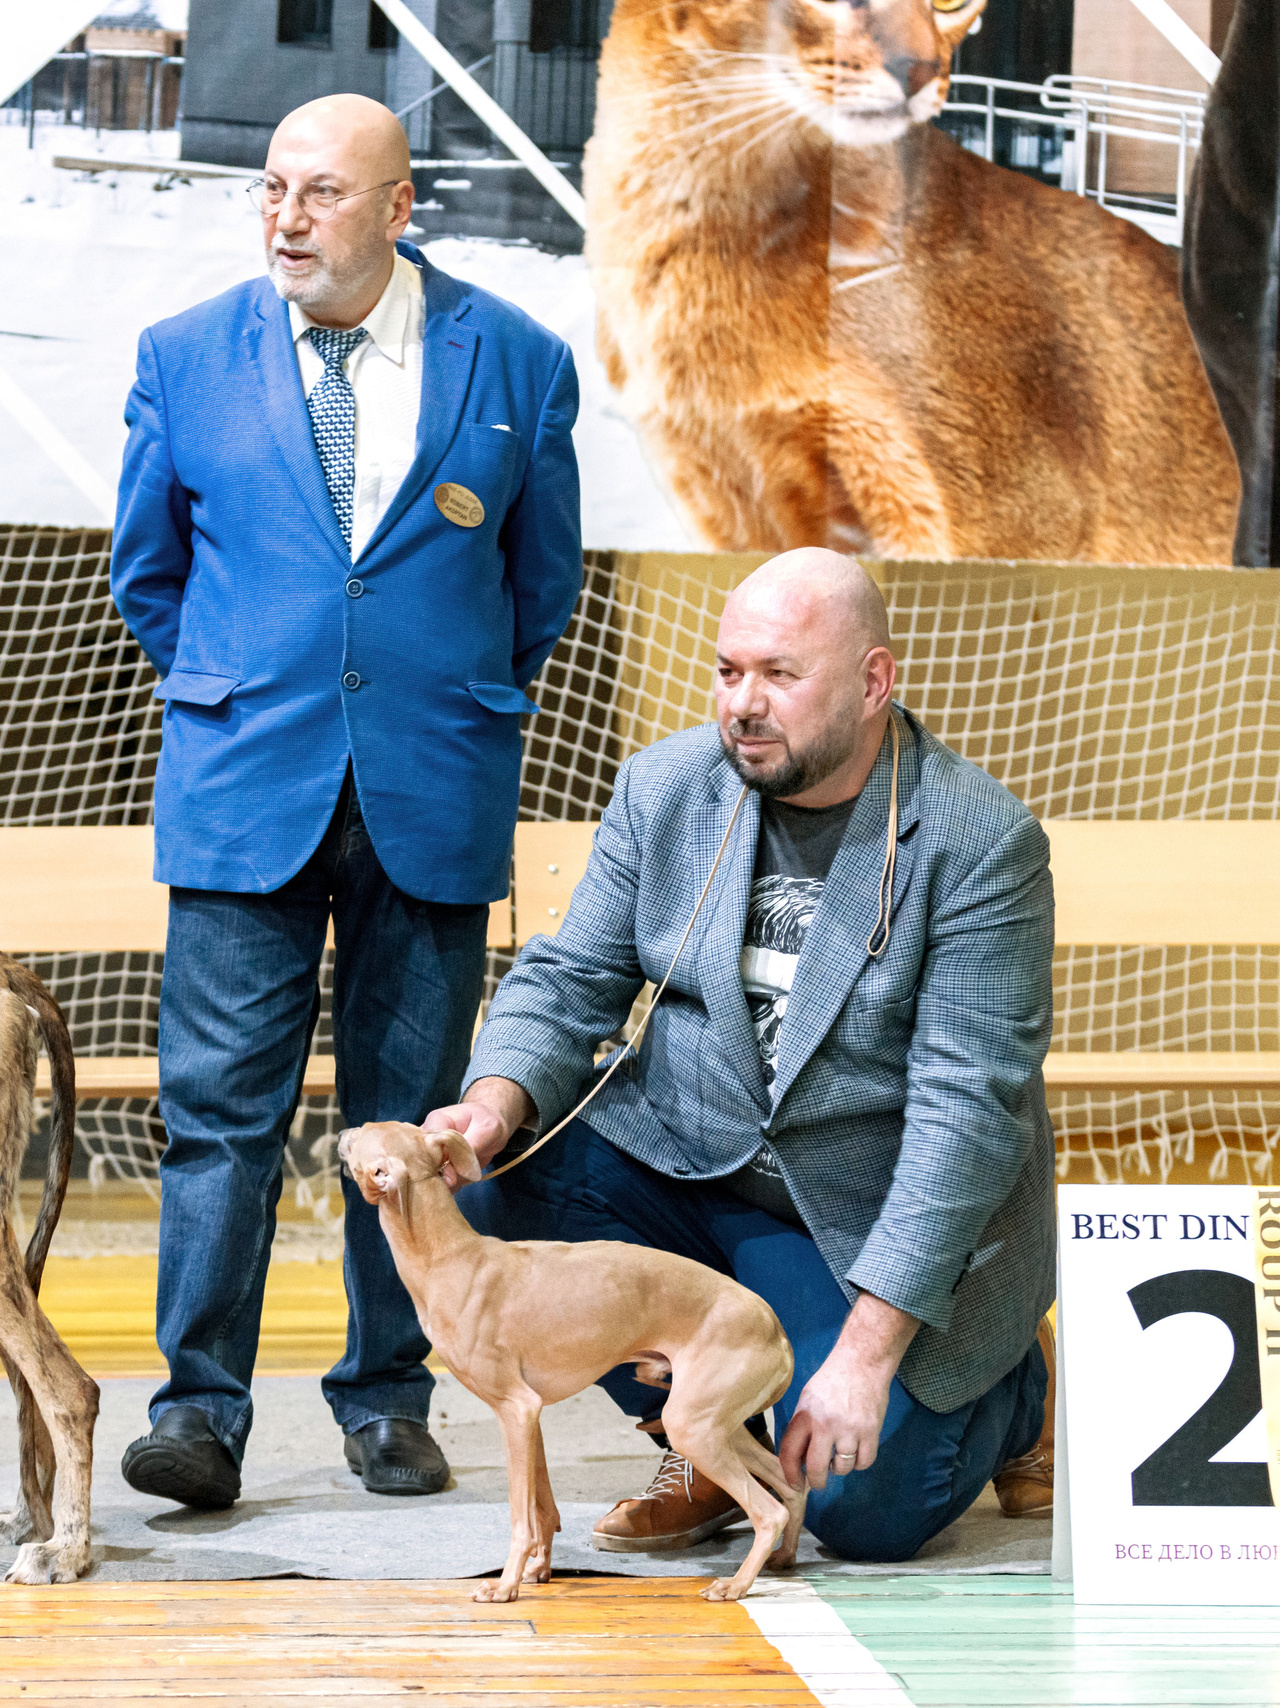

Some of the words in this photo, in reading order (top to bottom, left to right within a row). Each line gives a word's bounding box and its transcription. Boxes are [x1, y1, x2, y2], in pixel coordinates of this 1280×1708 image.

[1070, 1213, 1168, 1240] BEST
[1179, 1214, 1254, 1240] DIN
[1127, 1268, 1276, 1507] 2
[1114, 1543, 1153, 1560] ВСЕ
[1158, 1543, 1213, 1562] ДЕЛО
[1219, 1544, 1232, 1560] В
